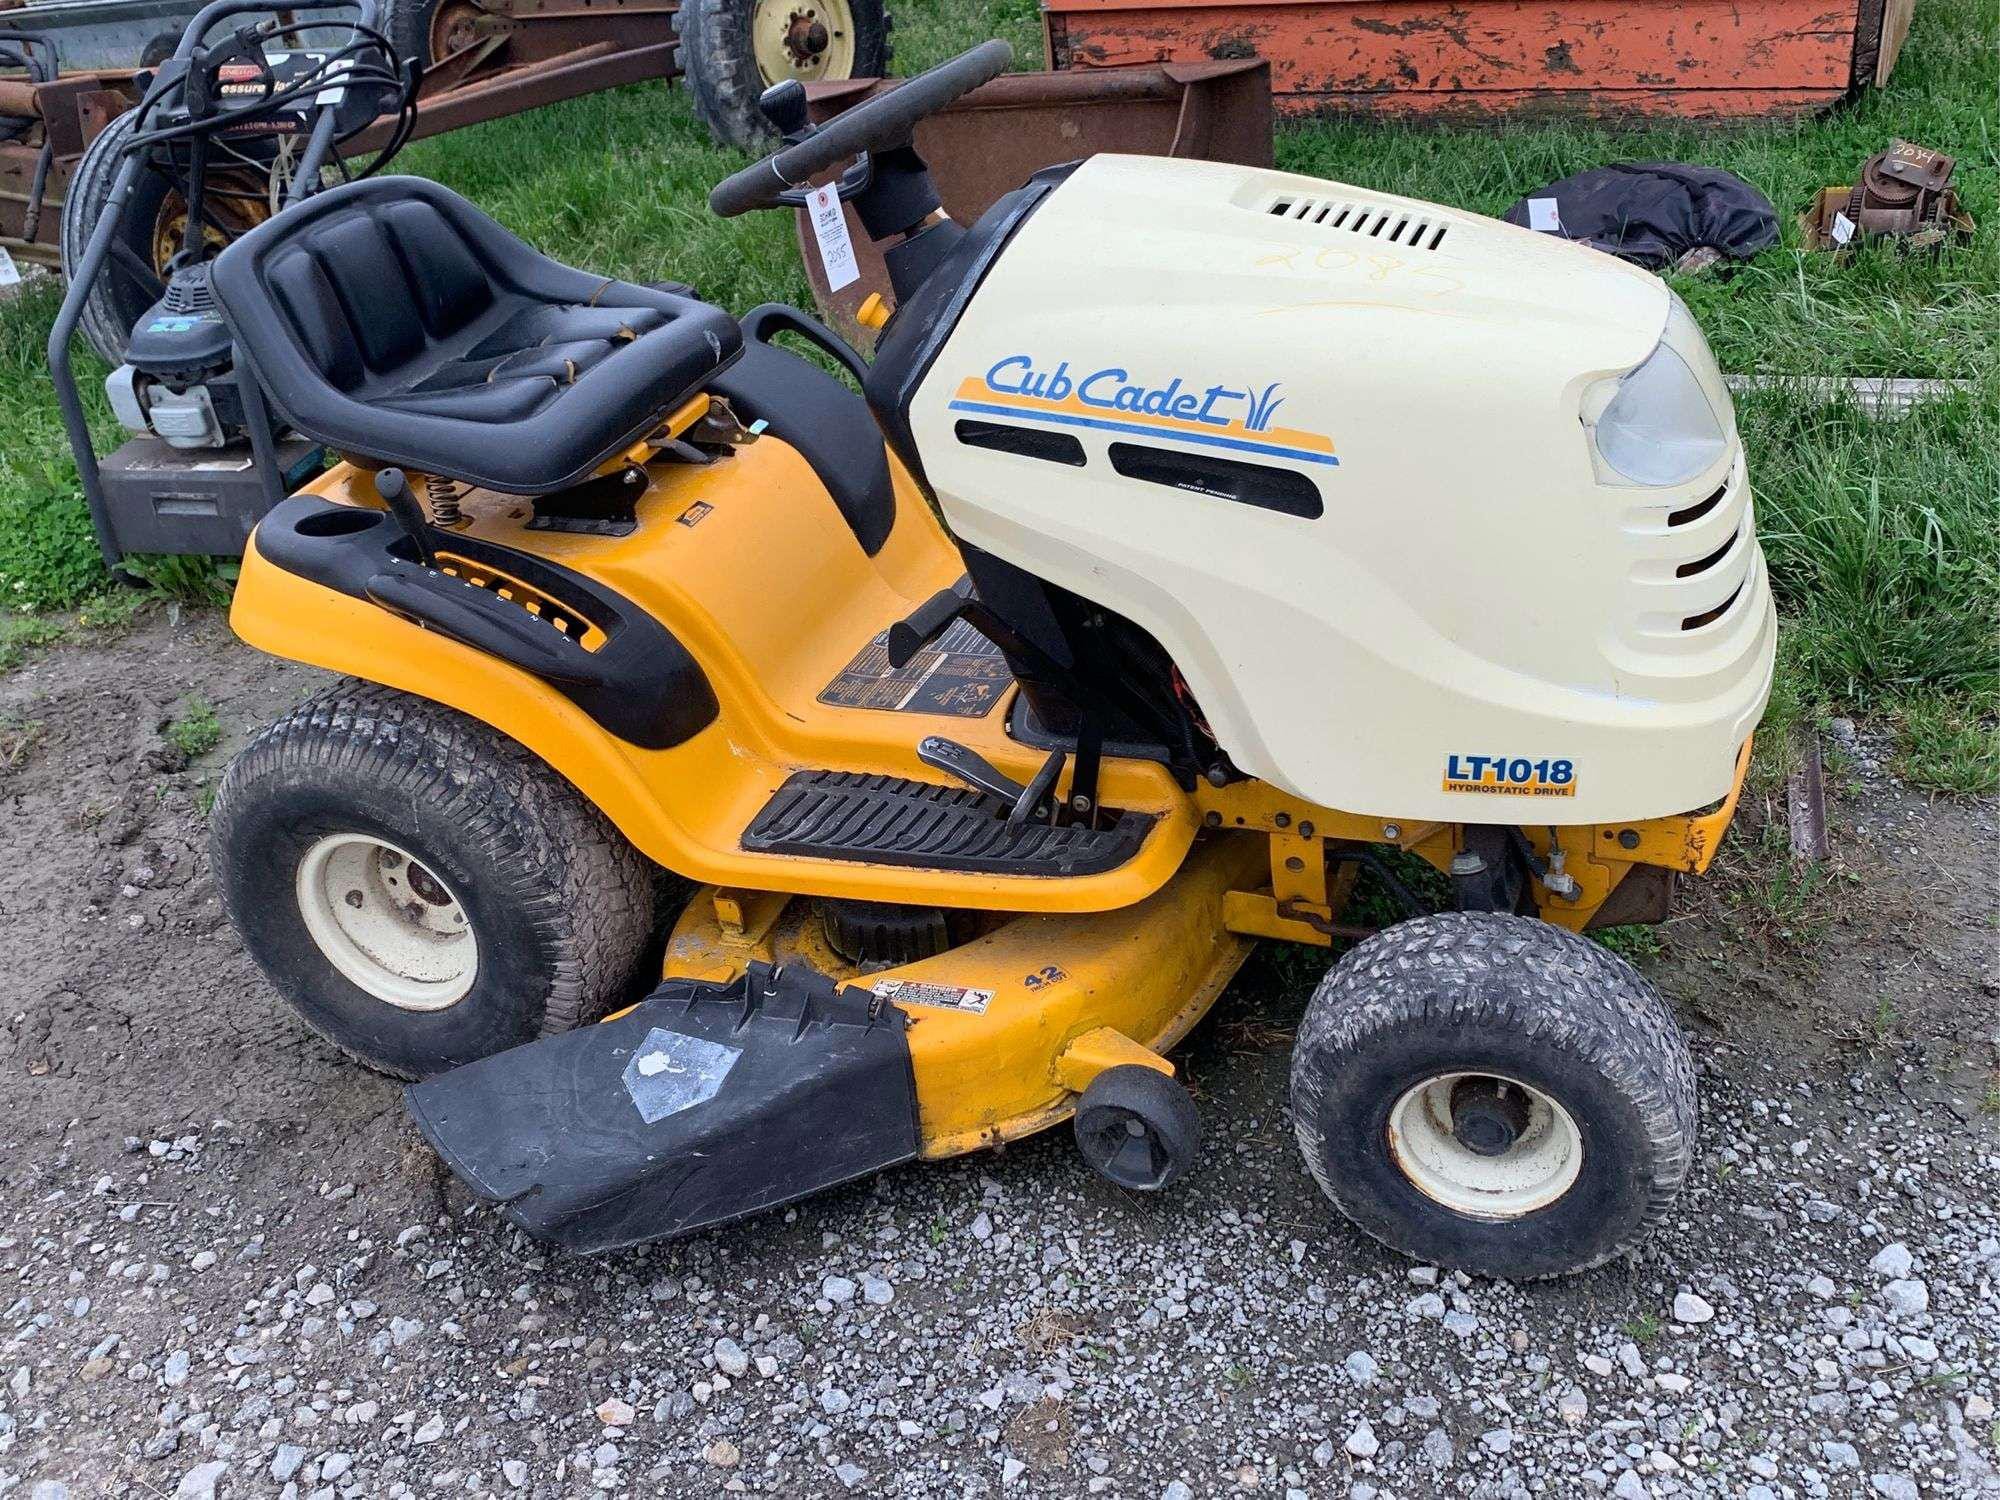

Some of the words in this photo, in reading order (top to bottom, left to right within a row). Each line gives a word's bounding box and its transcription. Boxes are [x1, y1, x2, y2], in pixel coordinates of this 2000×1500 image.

[221, 83, 266, 93] essure
[1255, 241, 1466, 296] 2085
[985, 355, 1072, 400] Cub
[1077, 368, 1247, 426] Cadet
[1177, 482, 1205, 493] PATENT
[1447, 755, 1573, 784] LT1018
[1448, 783, 1530, 795] HYDROSTATIC
[1533, 787, 1569, 796] DRIVE
[1024, 966, 1062, 986] 42
